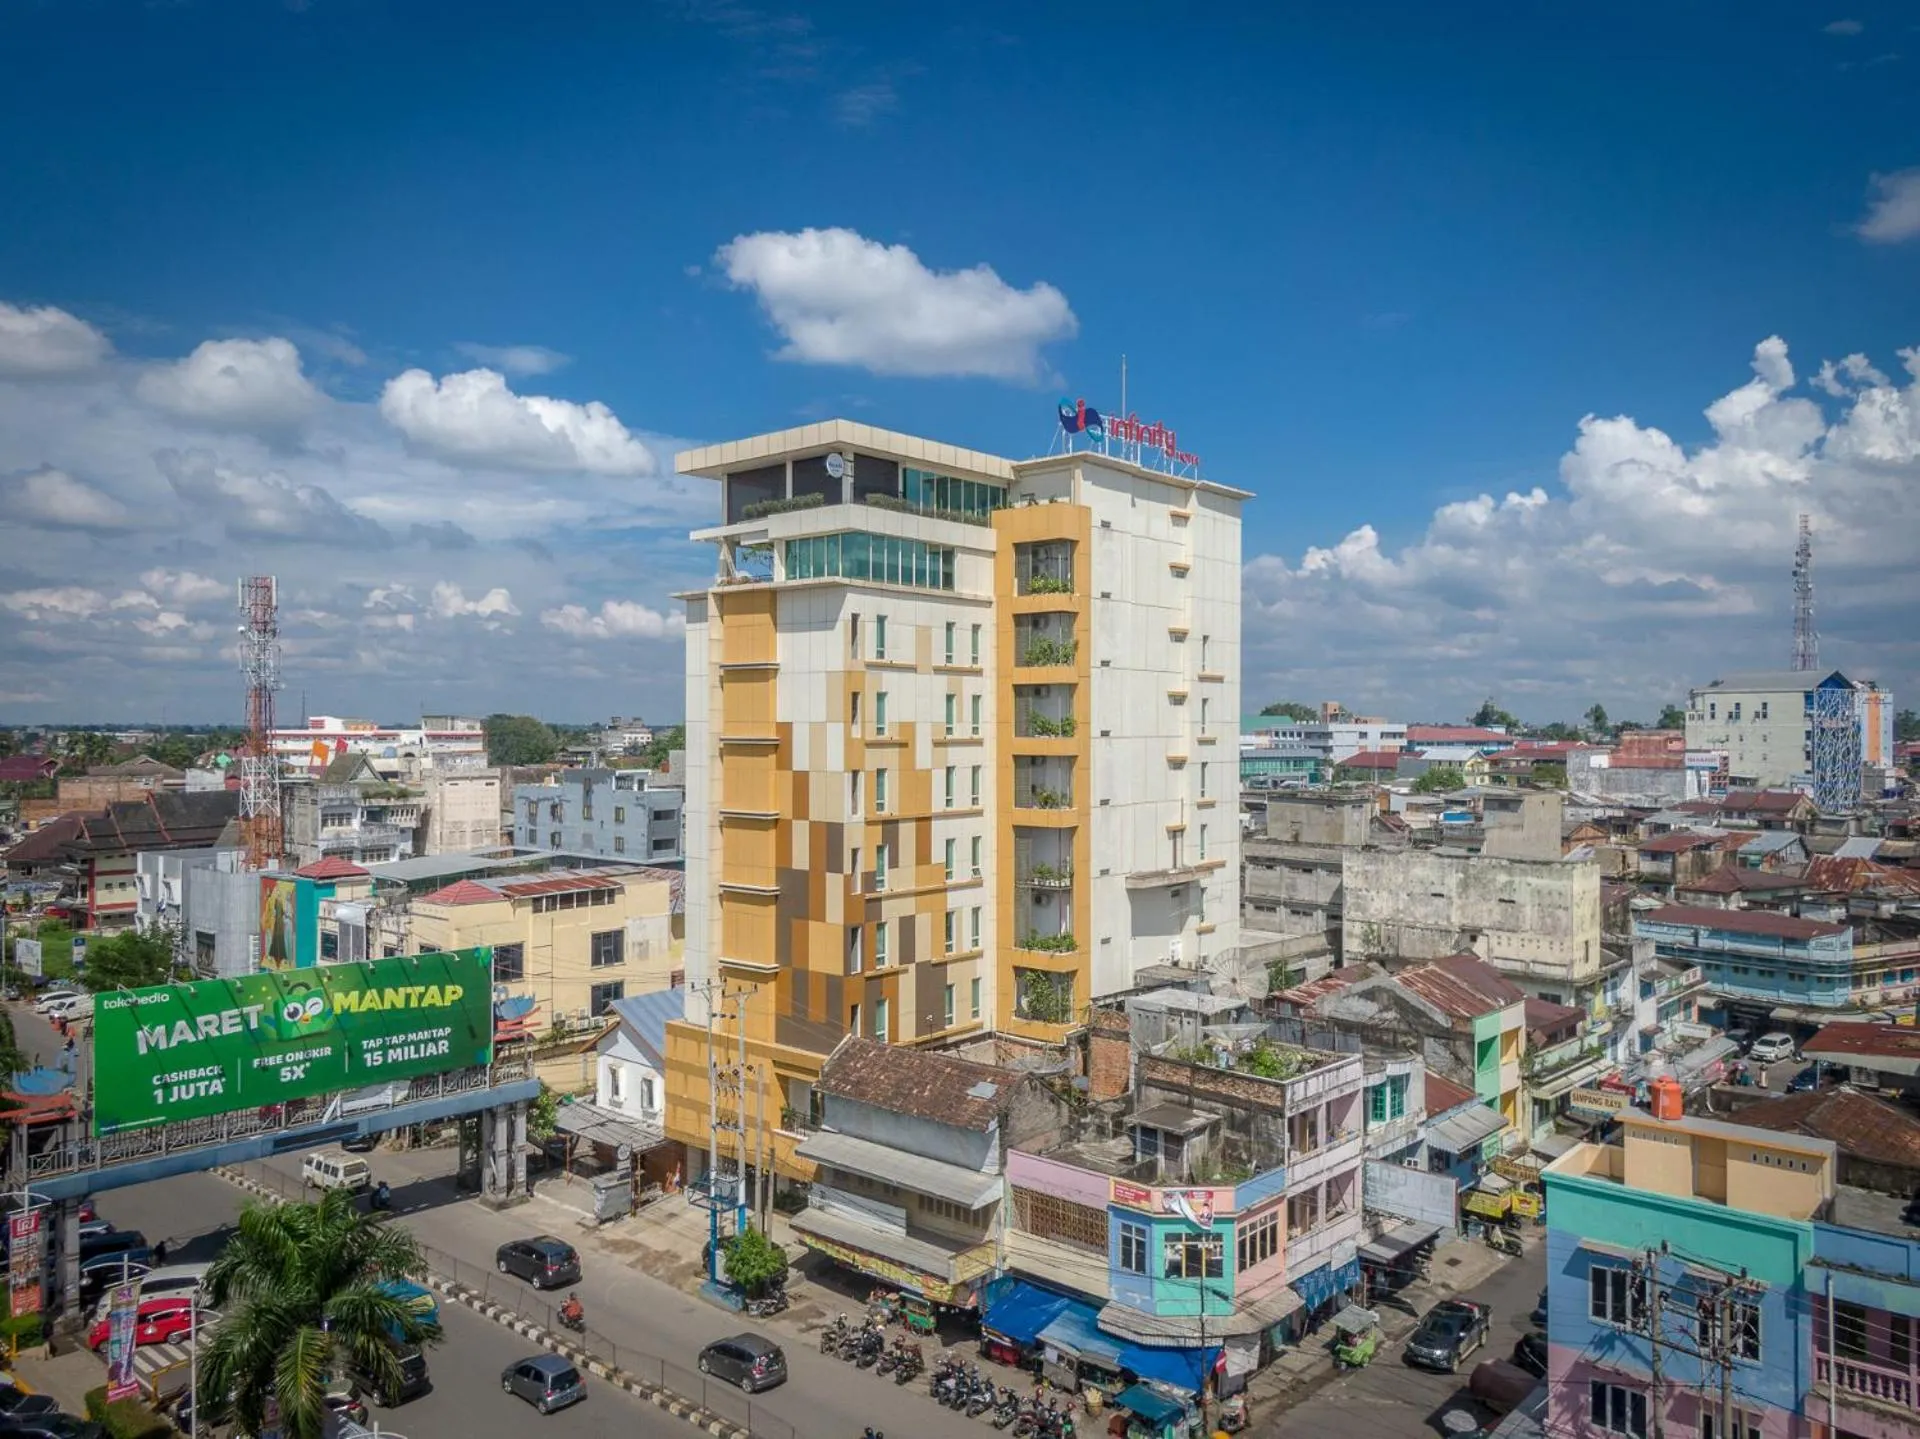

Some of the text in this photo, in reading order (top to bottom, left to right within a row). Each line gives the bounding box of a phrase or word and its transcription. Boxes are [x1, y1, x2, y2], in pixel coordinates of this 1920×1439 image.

[1110, 412, 1175, 457] infinity
[136, 984, 464, 1055] MARET MANTAP
[361, 1026, 452, 1049] TAP TAP MANTAP
[253, 1046, 332, 1068] FREE ONGKIR
[363, 1039, 450, 1067] 15 MILIAR
[152, 1064, 223, 1085] CASHBACK
[153, 1088, 164, 1105] 1
